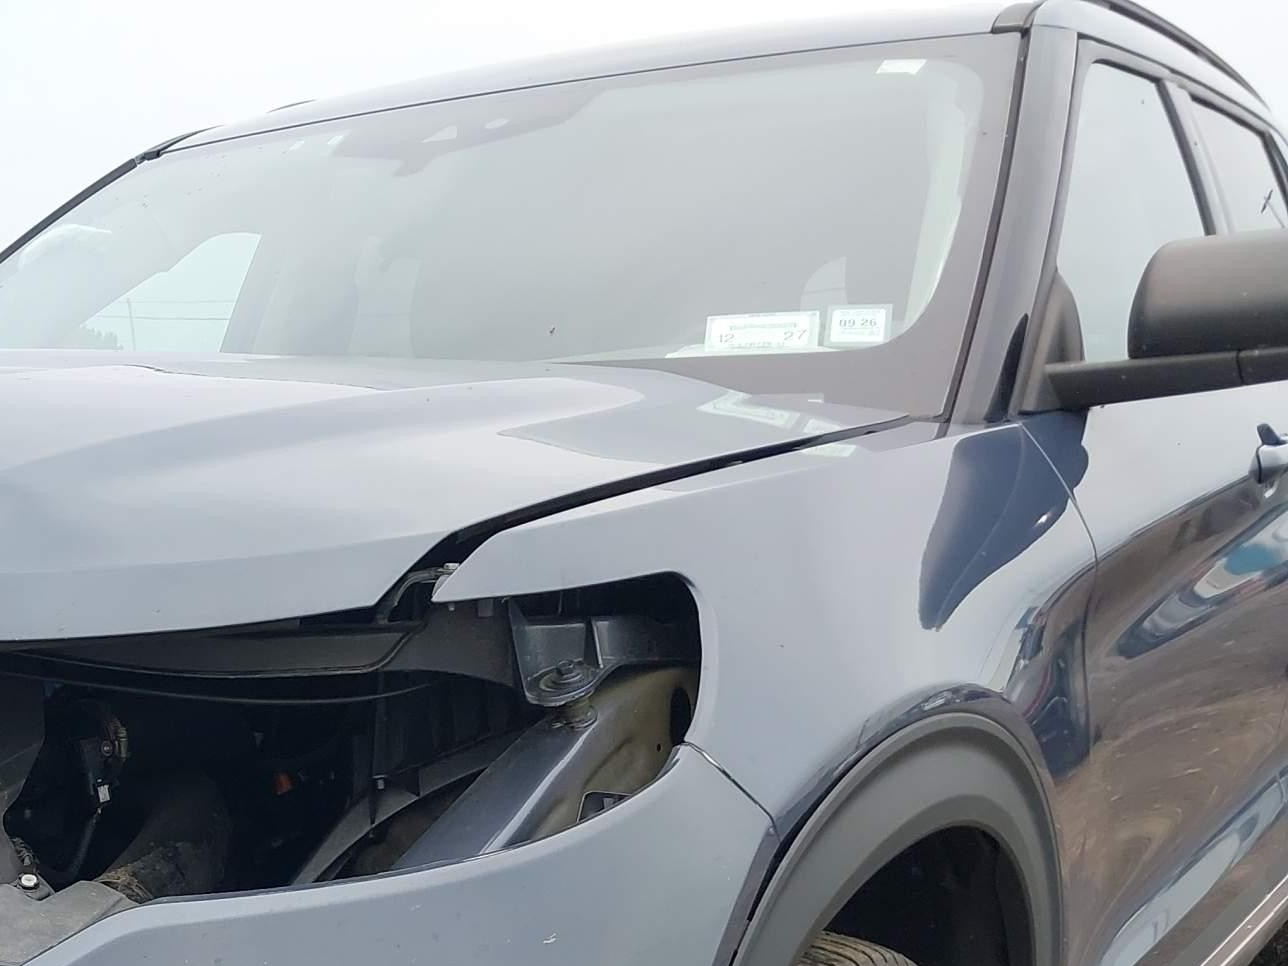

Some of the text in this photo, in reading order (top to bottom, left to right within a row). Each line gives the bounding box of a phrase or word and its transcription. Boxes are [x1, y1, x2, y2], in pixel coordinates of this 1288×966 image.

[839, 317, 877, 328] 09 26
[719, 329, 808, 343] 12 27
